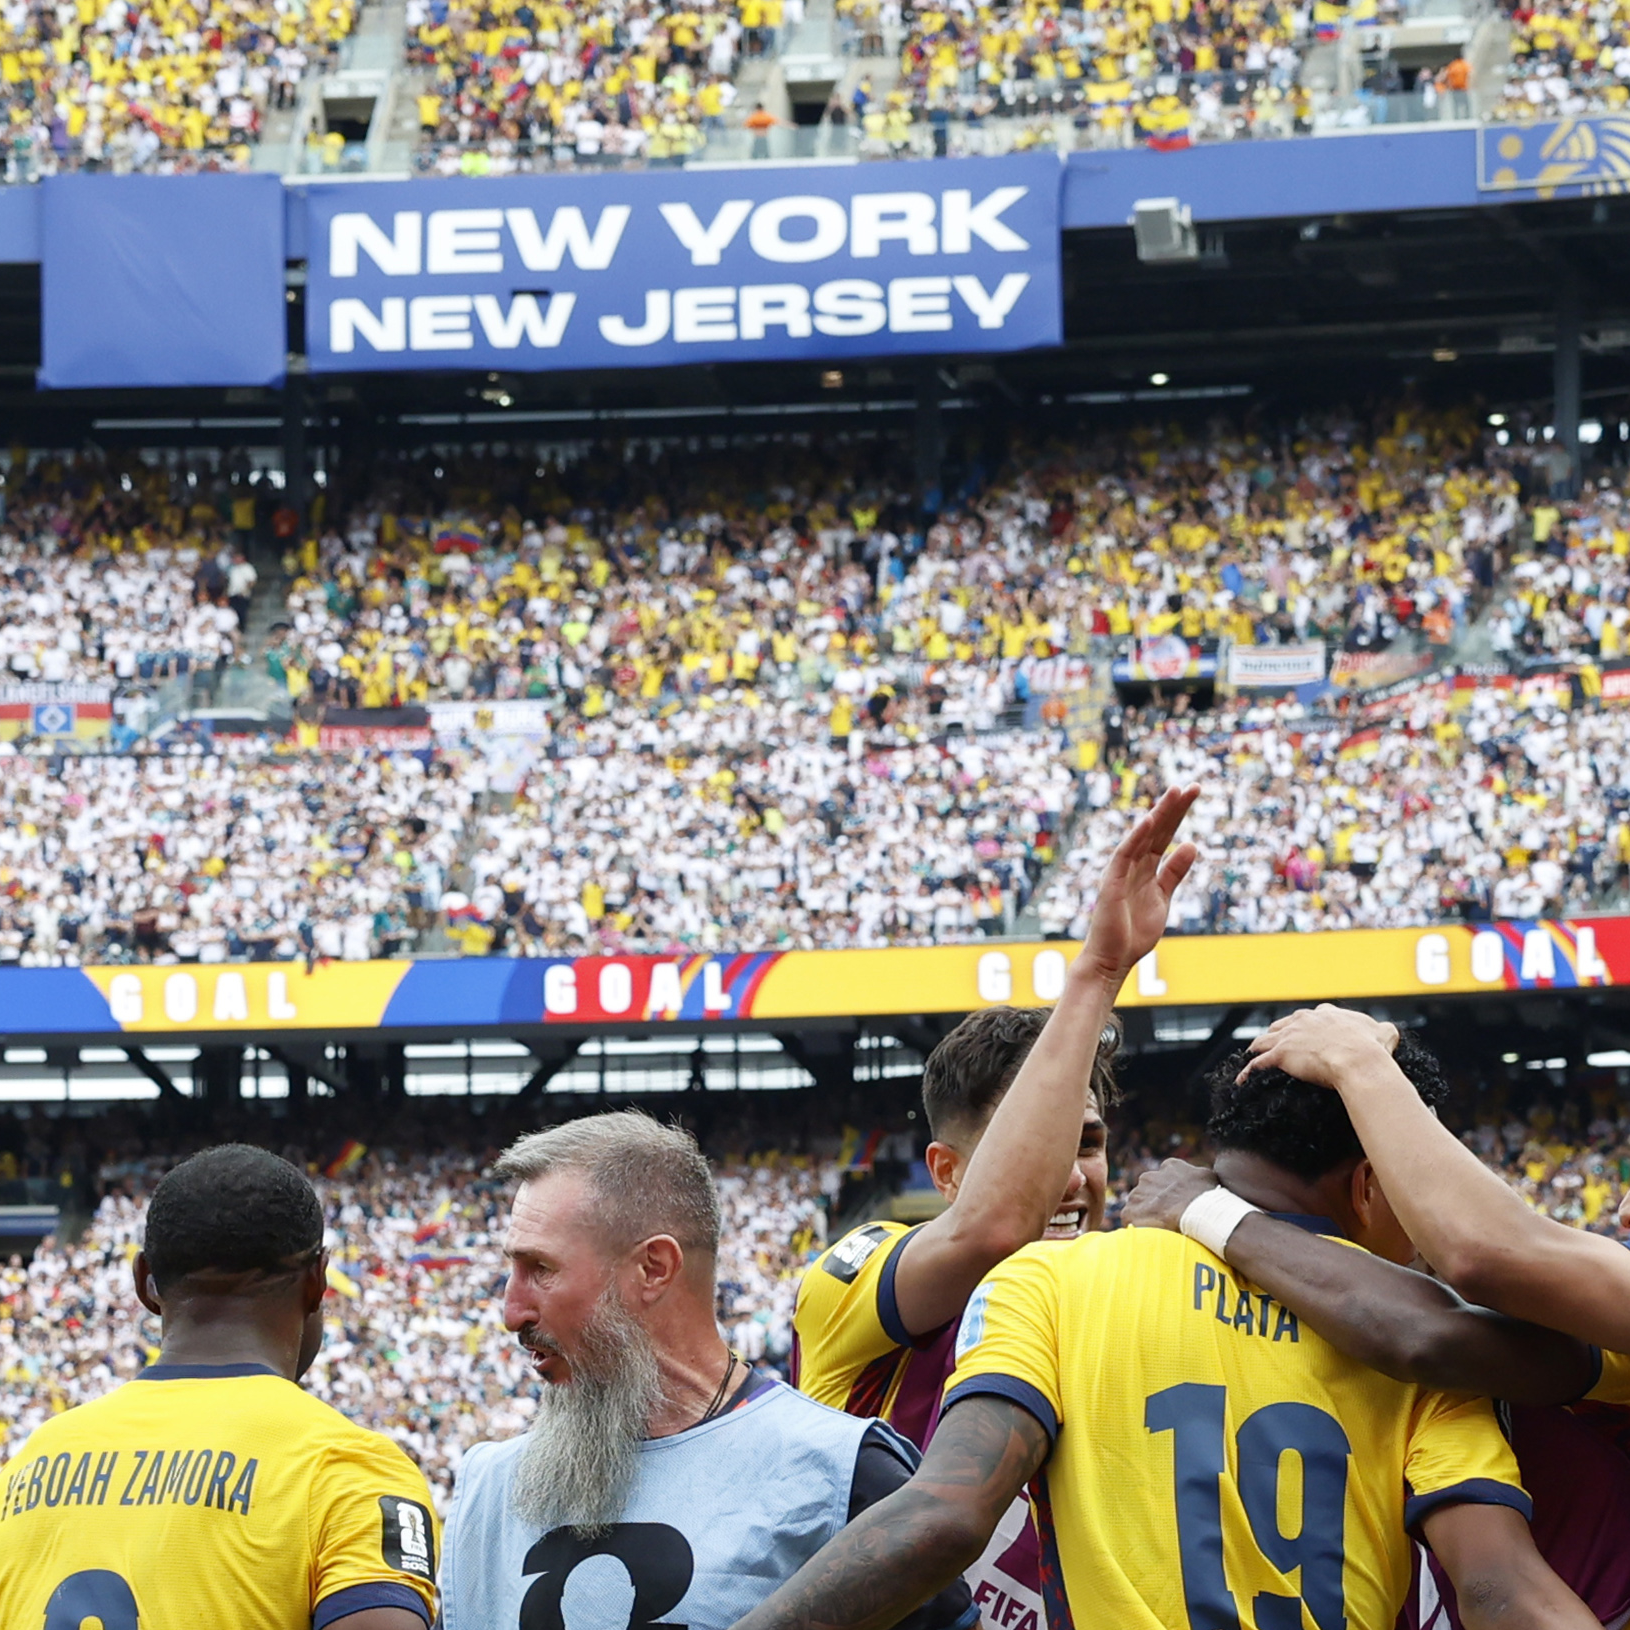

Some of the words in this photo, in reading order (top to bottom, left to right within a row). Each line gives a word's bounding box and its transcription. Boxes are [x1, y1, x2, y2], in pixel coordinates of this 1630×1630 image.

[329, 205, 631, 278] NEW
[660, 185, 1031, 265] YORK
[329, 293, 577, 354] NEW
[598, 272, 1031, 346] JERSEY
[543, 961, 731, 1014] GOAL
[977, 948, 1167, 1002] GOL
[1415, 926, 1606, 985] GOAL
[108, 971, 296, 1022] GOAL
[1193, 1261, 1300, 1344] PLATA
[0, 1450, 113, 1522] YEBOAH
[119, 1448, 260, 1517] ZAMORA
